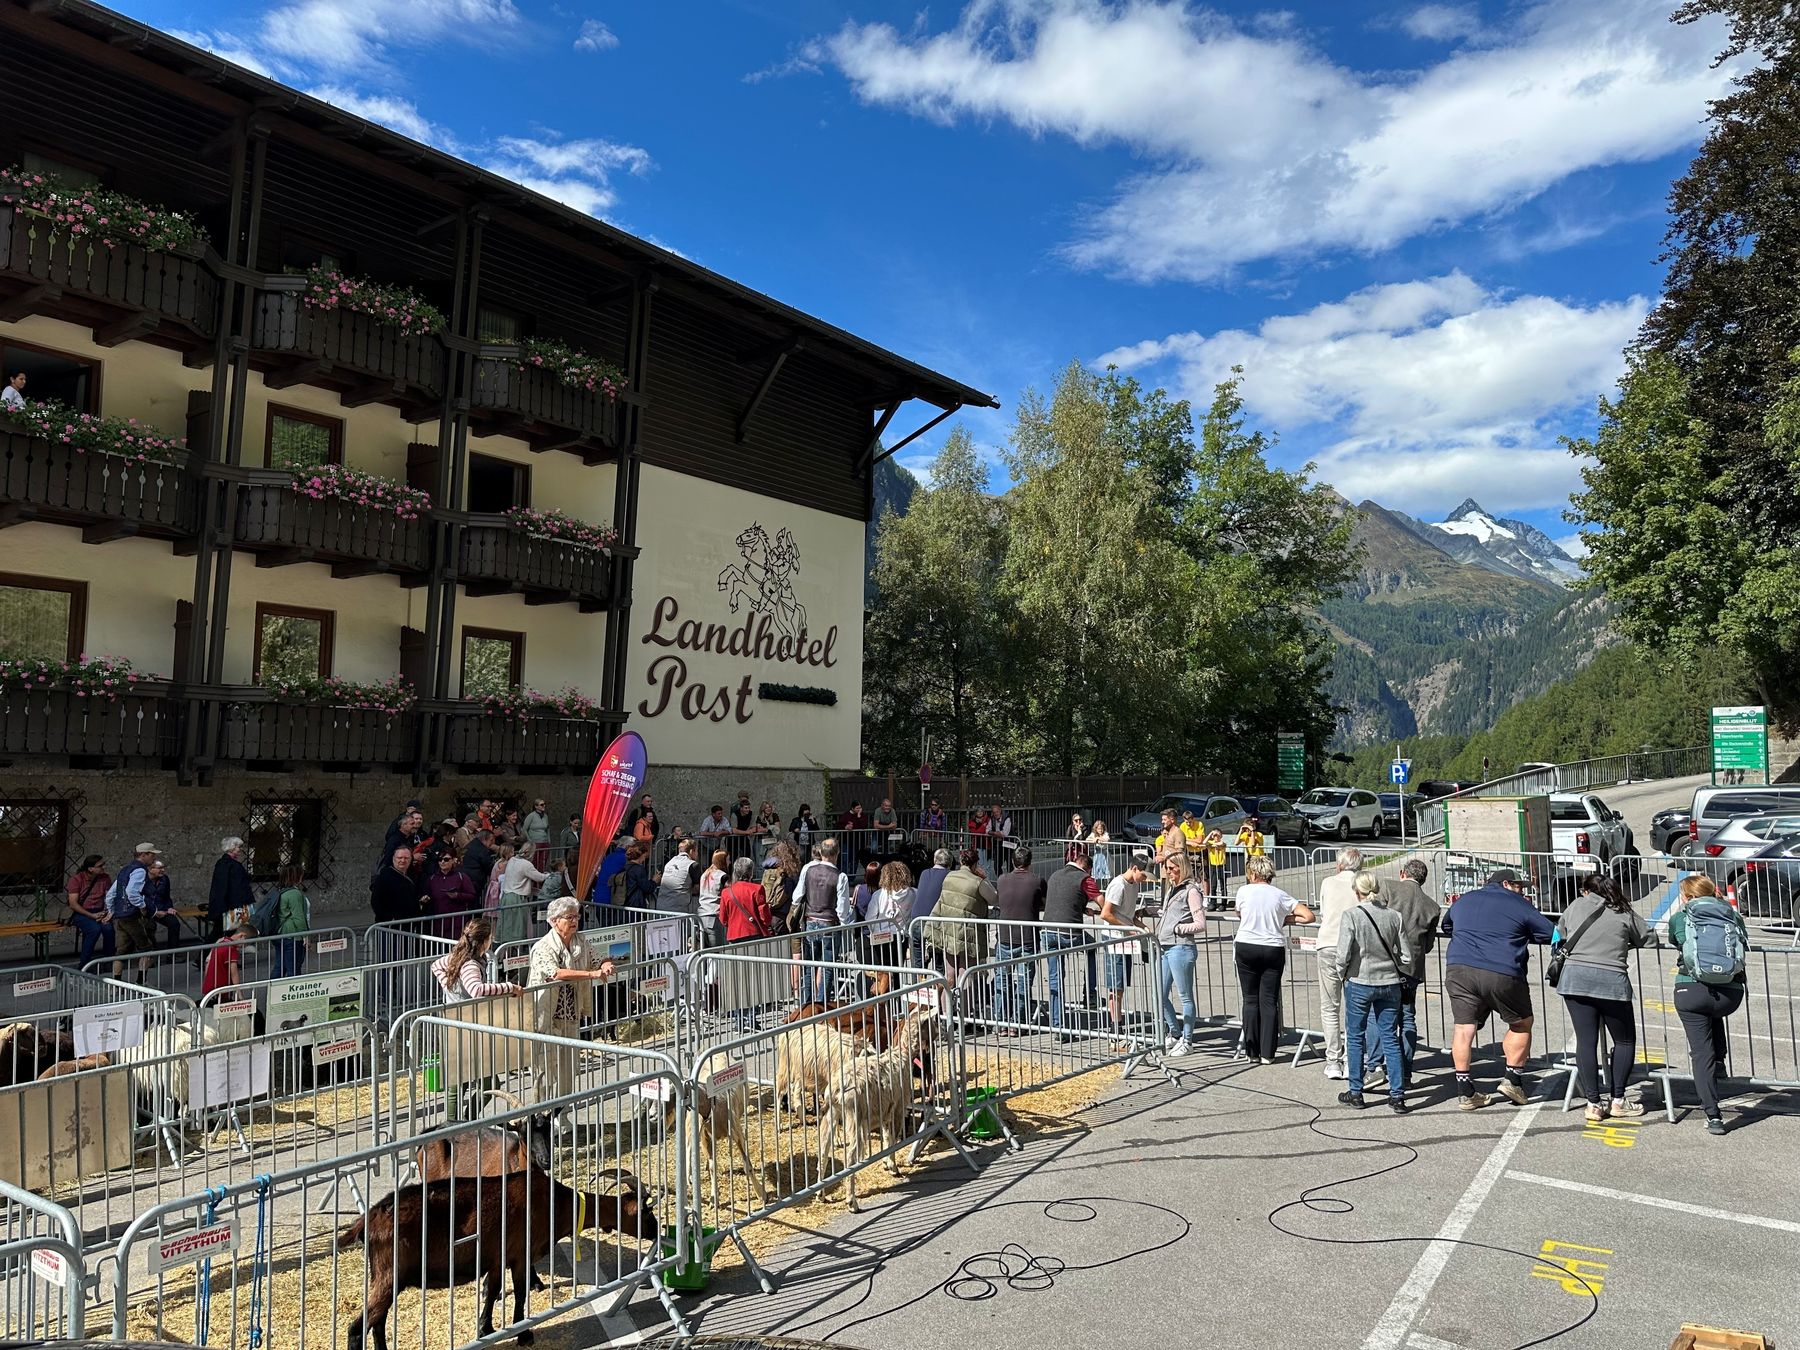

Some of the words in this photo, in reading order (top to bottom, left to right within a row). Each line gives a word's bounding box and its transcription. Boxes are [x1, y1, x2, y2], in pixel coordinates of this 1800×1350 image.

[642, 596, 837, 668] Landhotel
[638, 655, 753, 724] Post
[600, 777, 635, 789] ZUCHTVERBAND
[601, 769, 616, 778] SCHAF
[620, 773, 636, 783] ZIEGEN
[1724, 924, 1732, 957] ORTOVOX
[19, 982, 51, 991] VITZTHUM
[289, 982, 322, 992] Krainer
[281, 988, 329, 1001] Steinschaf
[220, 1004, 252, 1013] VITZTHUM
[319, 1043, 356, 1057] VITZTHUM
[161, 1231, 231, 1259] VITZTHUM
[1531, 1239, 1614, 1297] LHP
